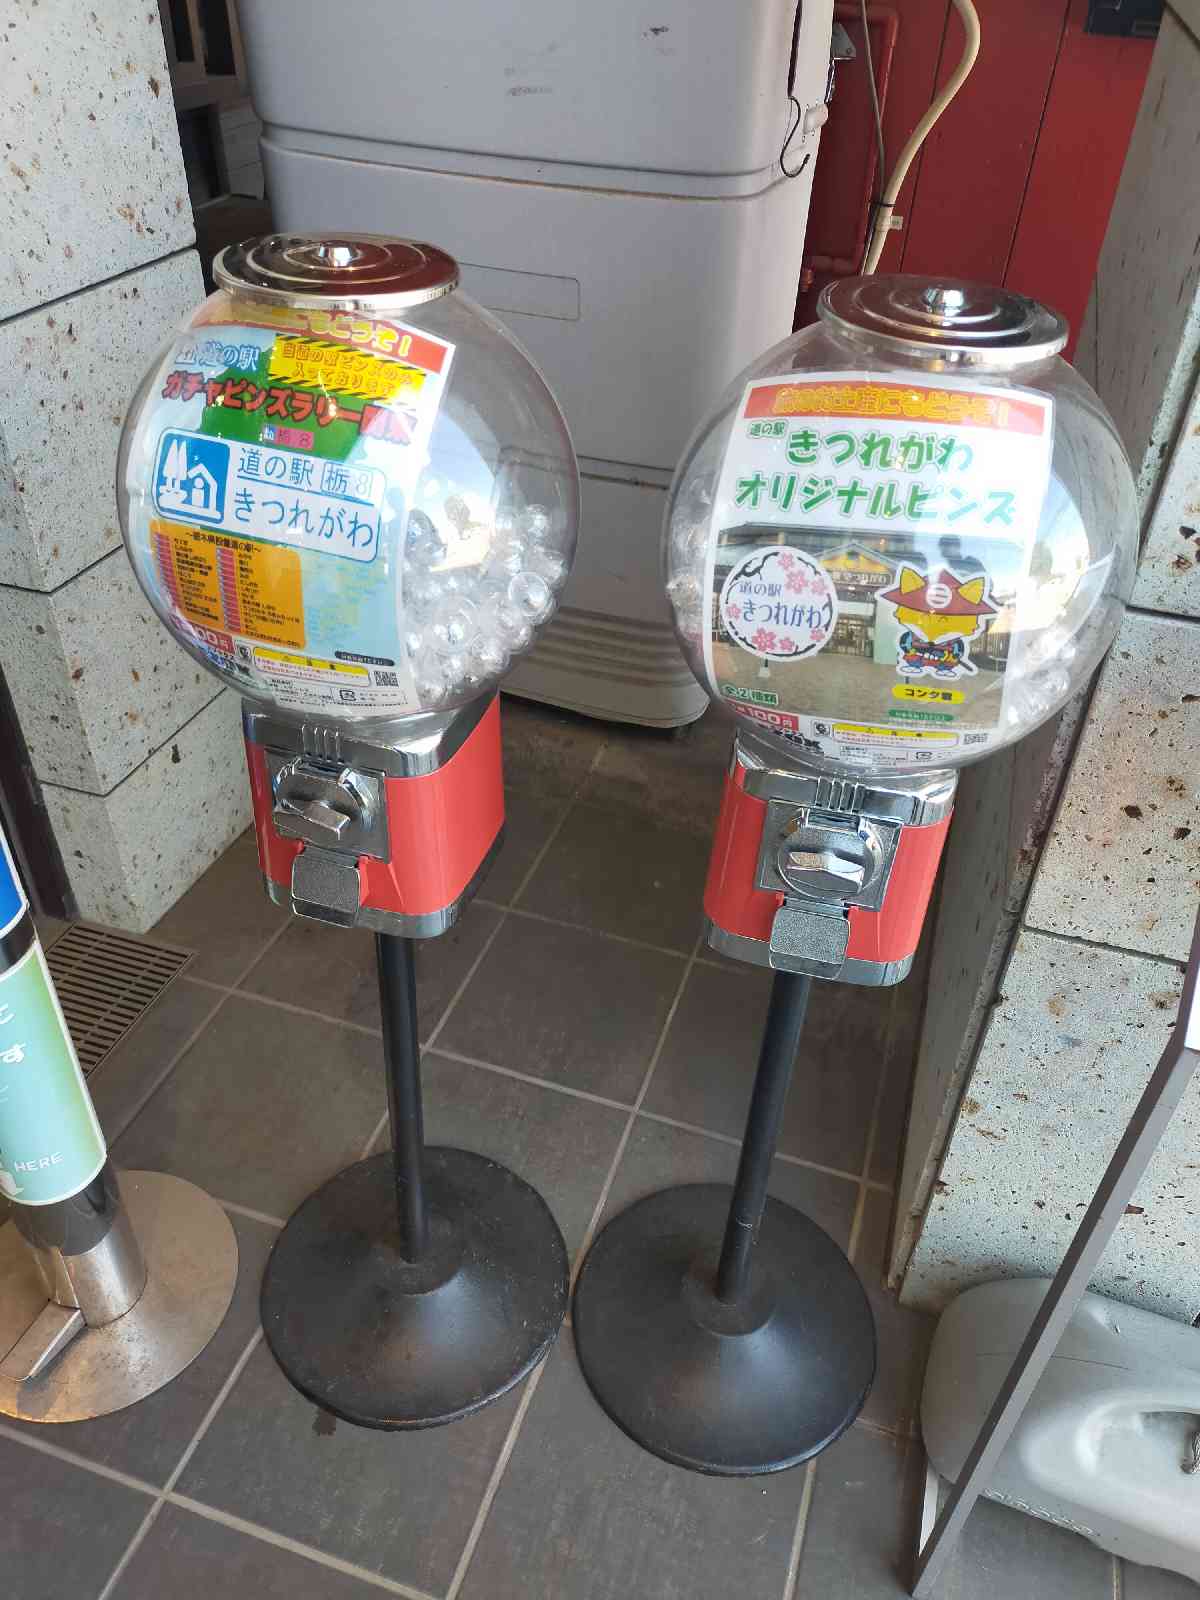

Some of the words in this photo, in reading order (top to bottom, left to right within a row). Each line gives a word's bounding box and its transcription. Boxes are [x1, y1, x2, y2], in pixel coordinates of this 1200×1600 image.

[749, 421, 786, 438] 道の駅
[786, 428, 974, 472] きつれがわ
[237, 446, 314, 487] 道の駅
[325, 464, 349, 493] 栃
[233, 487, 374, 548] きつれがわ
[735, 472, 1017, 526] オリジナルピンズ
[739, 582, 782, 597] 道の駅
[14, 1152, 64, 1174] HERE
